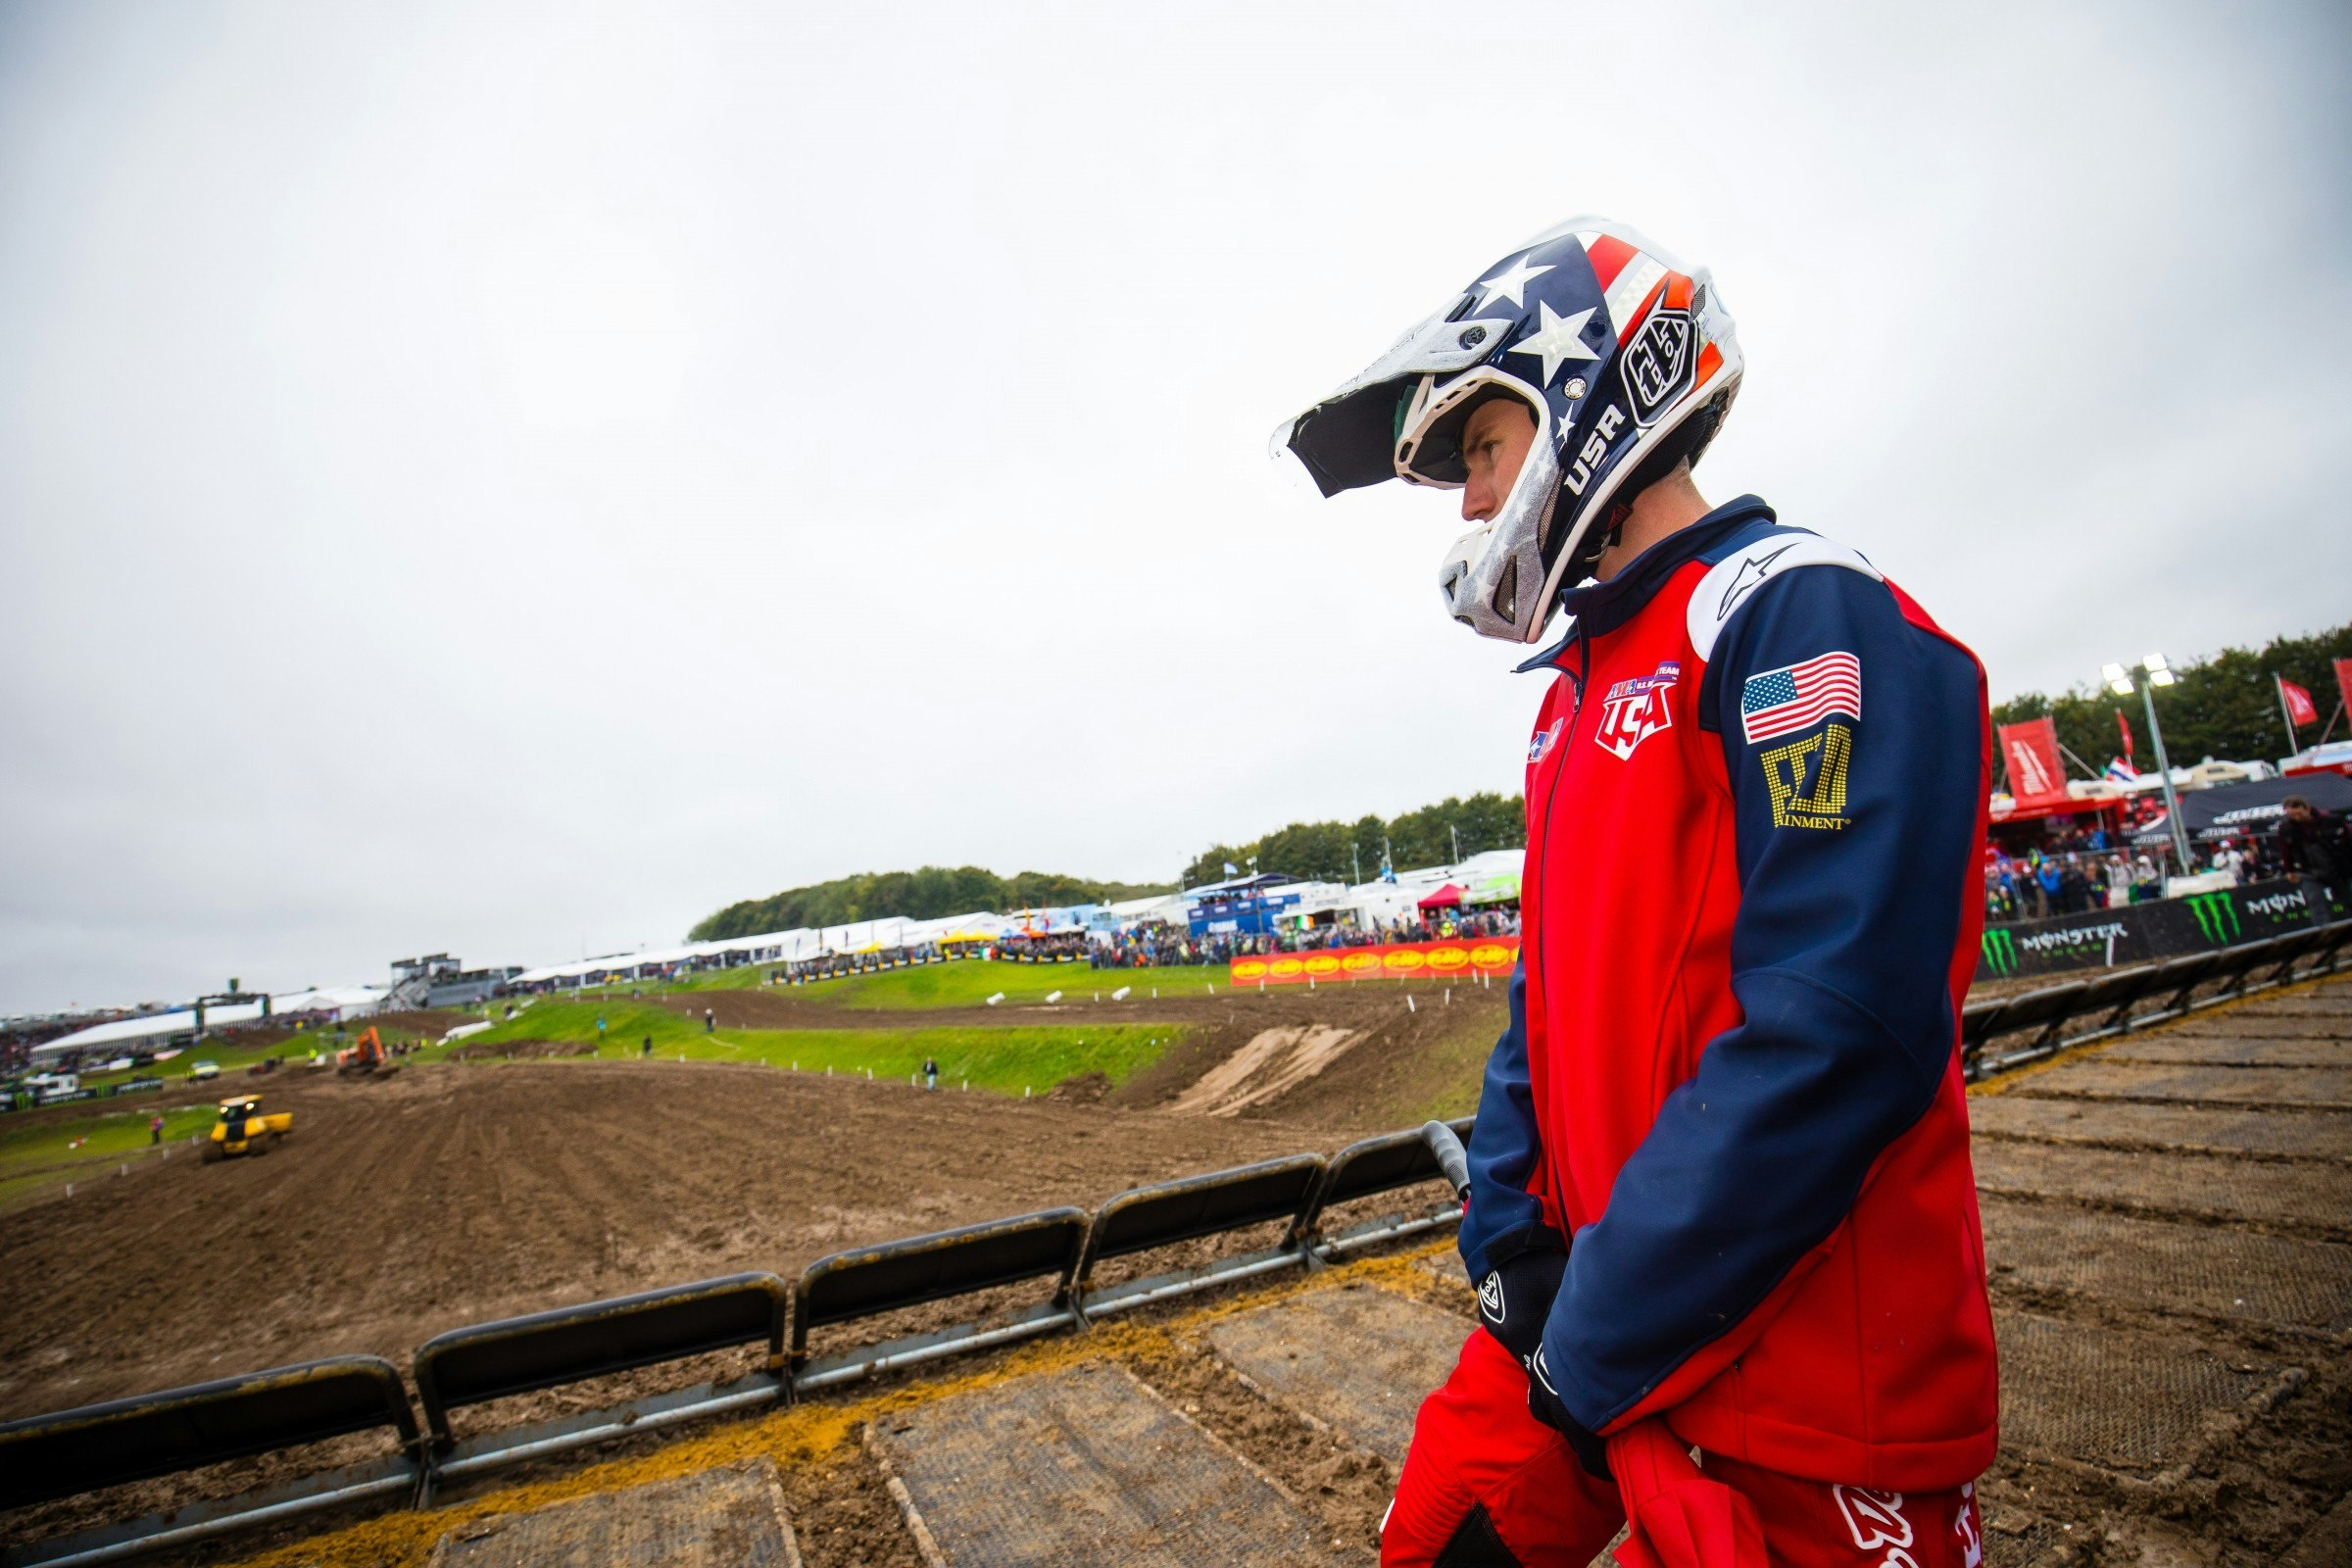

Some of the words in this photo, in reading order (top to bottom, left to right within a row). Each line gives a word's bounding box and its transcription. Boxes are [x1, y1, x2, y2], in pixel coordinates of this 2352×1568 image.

[1564, 403, 1626, 496] USA
[1658, 666, 1680, 676] TEAM
[1595, 682, 1672, 760] USA
[2021, 922, 2129, 952] MONSTER
